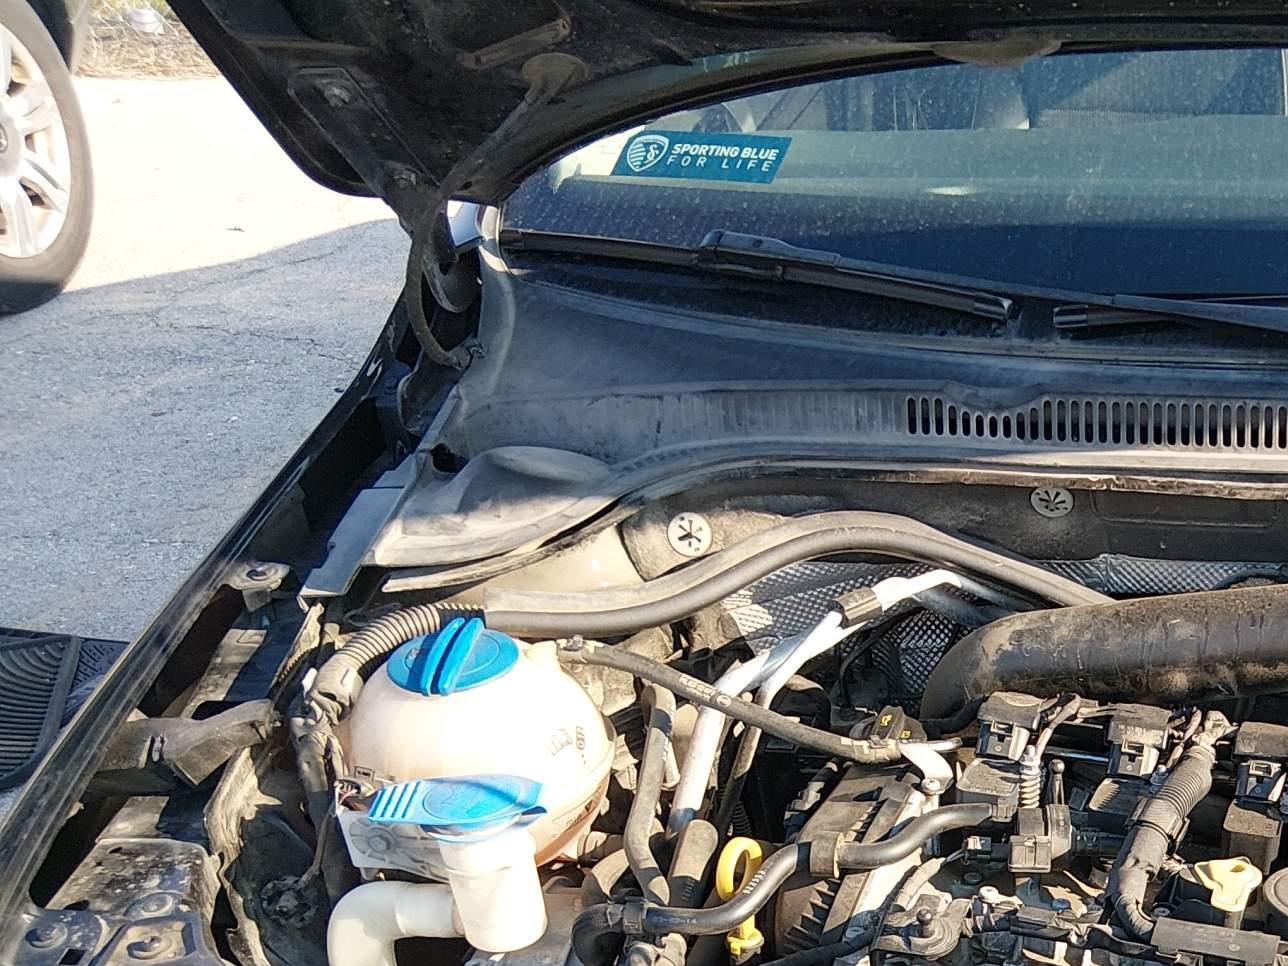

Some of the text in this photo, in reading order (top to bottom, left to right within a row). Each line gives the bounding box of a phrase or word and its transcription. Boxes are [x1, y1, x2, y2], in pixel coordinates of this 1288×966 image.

[672, 143, 780, 161] SPORTING BLUE
[666, 155, 775, 172] FOR LIFE
